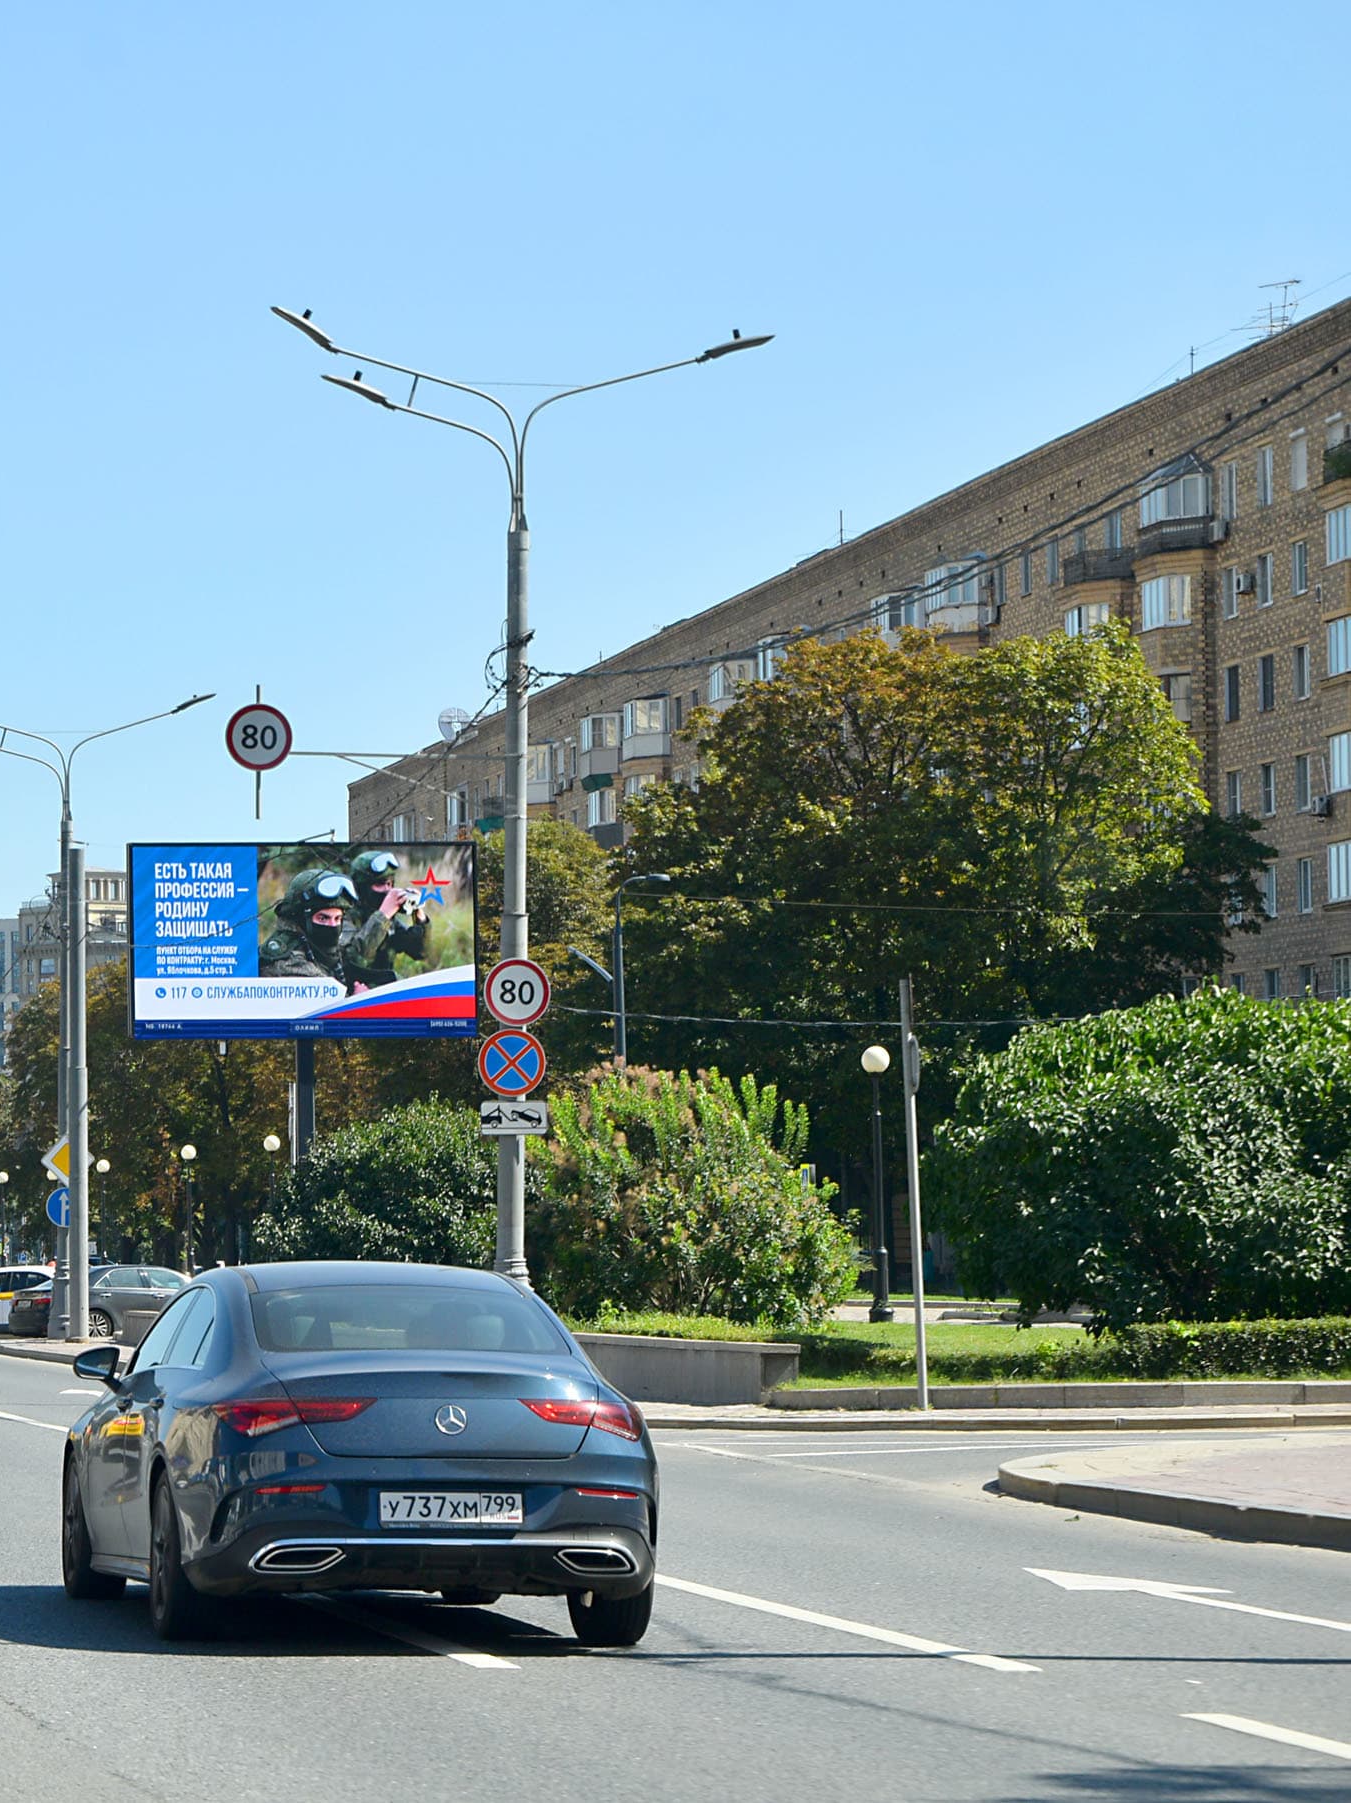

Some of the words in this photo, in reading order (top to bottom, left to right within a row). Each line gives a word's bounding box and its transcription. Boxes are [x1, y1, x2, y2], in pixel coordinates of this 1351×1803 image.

[241, 724, 277, 750] 80
[154, 862, 187, 879] ЕСТЬ
[189, 862, 232, 879] ТАКАЯ
[155, 882, 234, 898] ПРОФЕССИЯ
[155, 901, 209, 919] РОДИНУ
[155, 920, 233, 939] ЗАЩИЩАТЬ
[156, 945, 177, 954] ПУНКТ
[178, 946, 202, 954] ОТБОРА
[202, 946, 211, 954] НА
[212, 946, 238, 954] СЛУЖБУ
[156, 956, 166, 964] ПО
[167, 956, 205, 964] КОНТРАКТУ:
[211, 956, 238, 966] Москва,
[171, 986, 187, 999] 117
[207, 985, 339, 1000] СЛУЖБАПОКОНТРАКТУ.РФ
[499, 979, 535, 1006] 80
[388, 1495, 479, 1518] У737ХМ
[482, 1495, 516, 1513] 799
